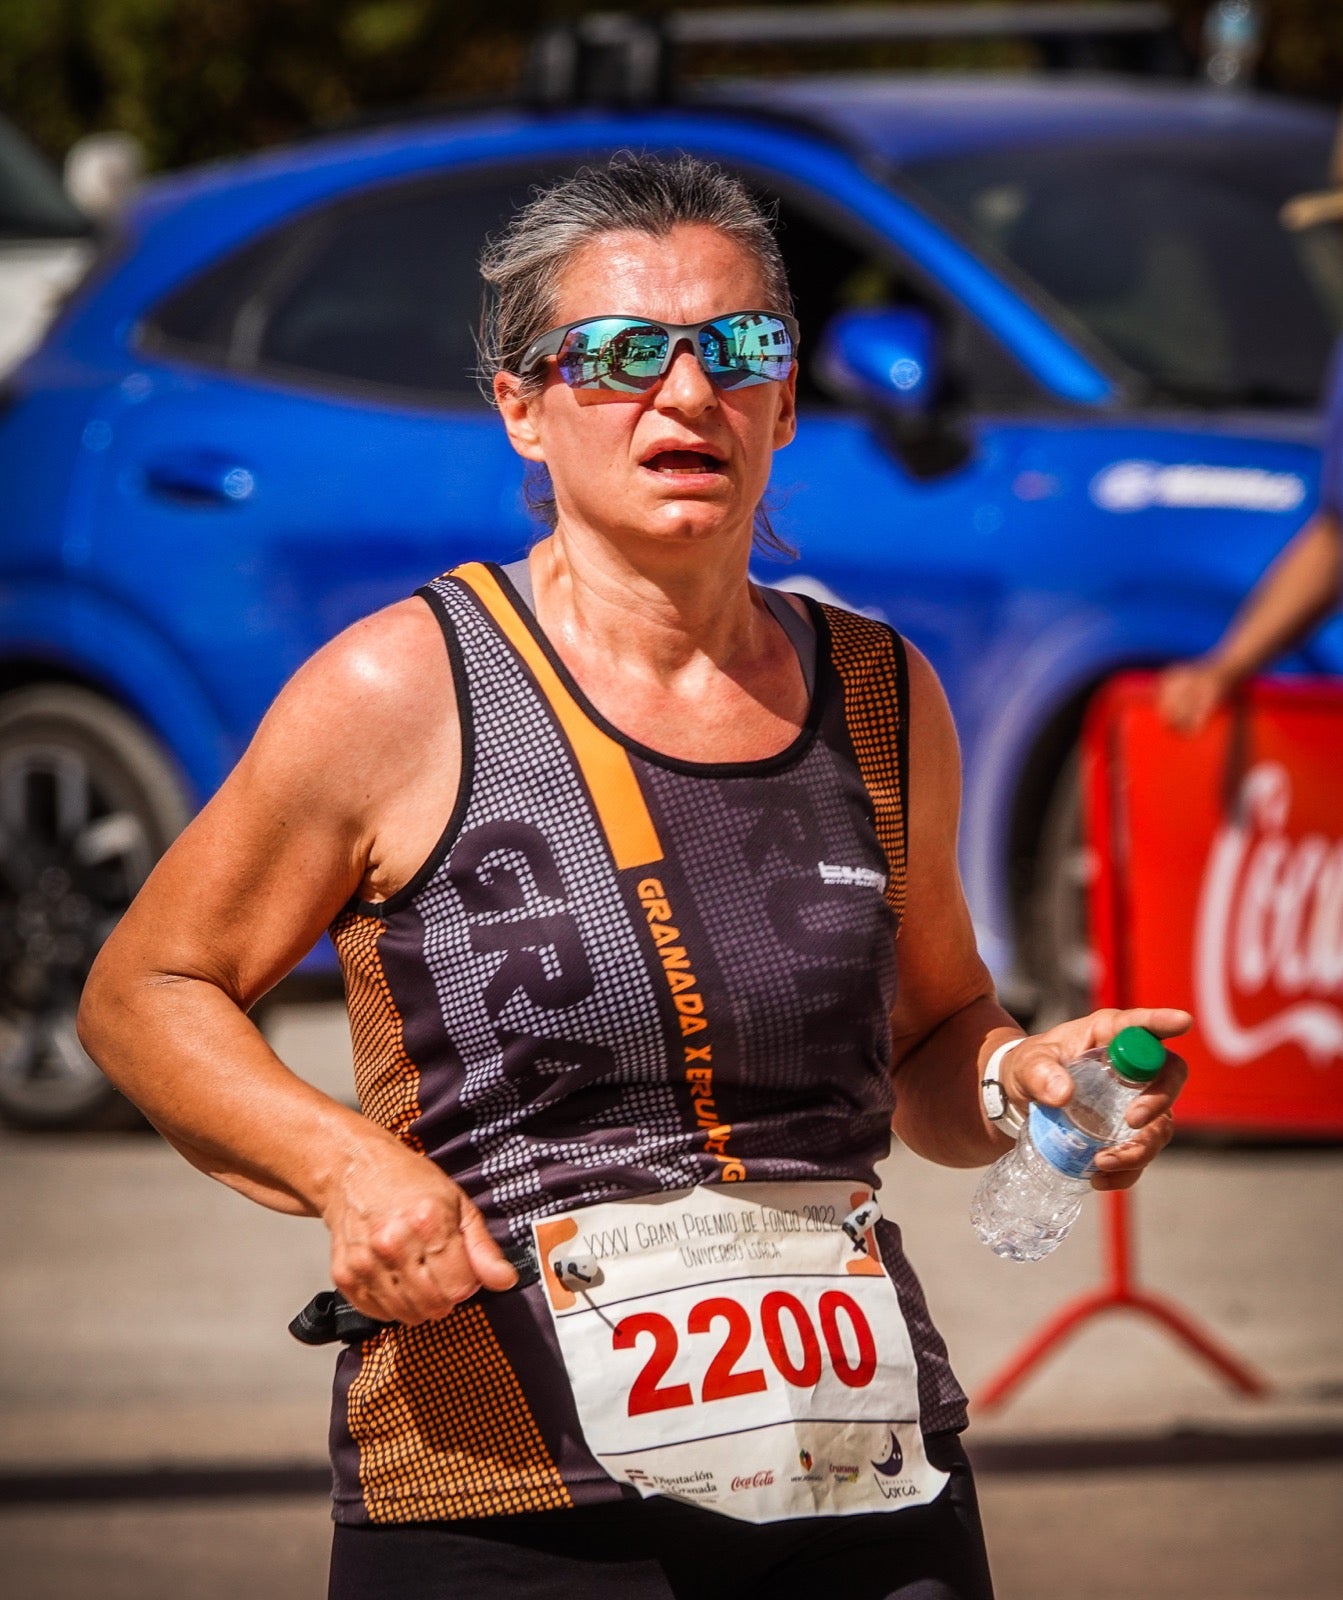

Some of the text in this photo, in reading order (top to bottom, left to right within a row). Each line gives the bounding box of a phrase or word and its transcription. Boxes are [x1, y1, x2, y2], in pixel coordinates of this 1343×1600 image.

[637, 878, 708, 1037] GRANADA
[684, 1043, 713, 1063] X
[583, 1226, 629, 1260] XXXV
[635, 1221, 680, 1249] GRAN
[682, 1211, 738, 1240] PREMIO
[760, 1204, 800, 1233] FONDO
[803, 1204, 838, 1233] 2022
[612, 1290, 877, 1417] 2200
